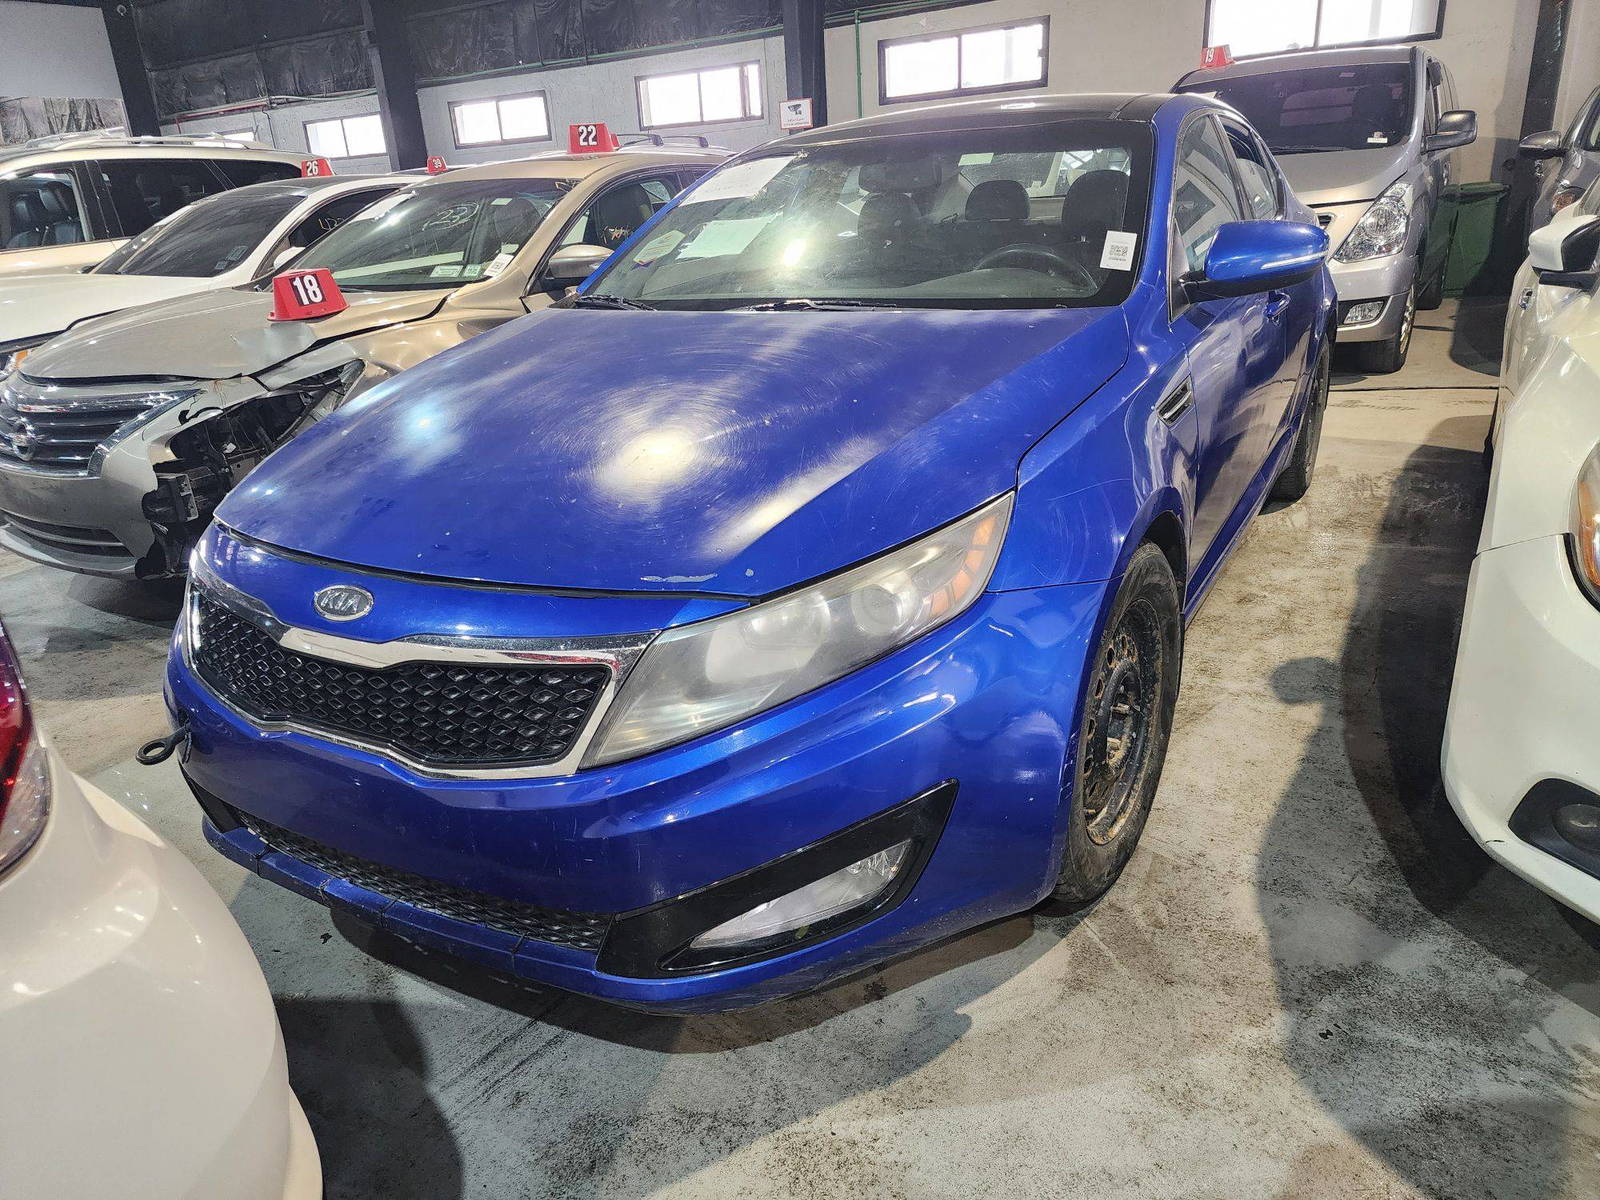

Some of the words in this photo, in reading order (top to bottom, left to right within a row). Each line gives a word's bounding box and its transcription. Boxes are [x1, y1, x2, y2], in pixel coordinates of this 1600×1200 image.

[578, 125, 597, 146] 22
[306, 161, 319, 176] 26
[293, 274, 323, 306] 18
[319, 588, 363, 614] KIA
